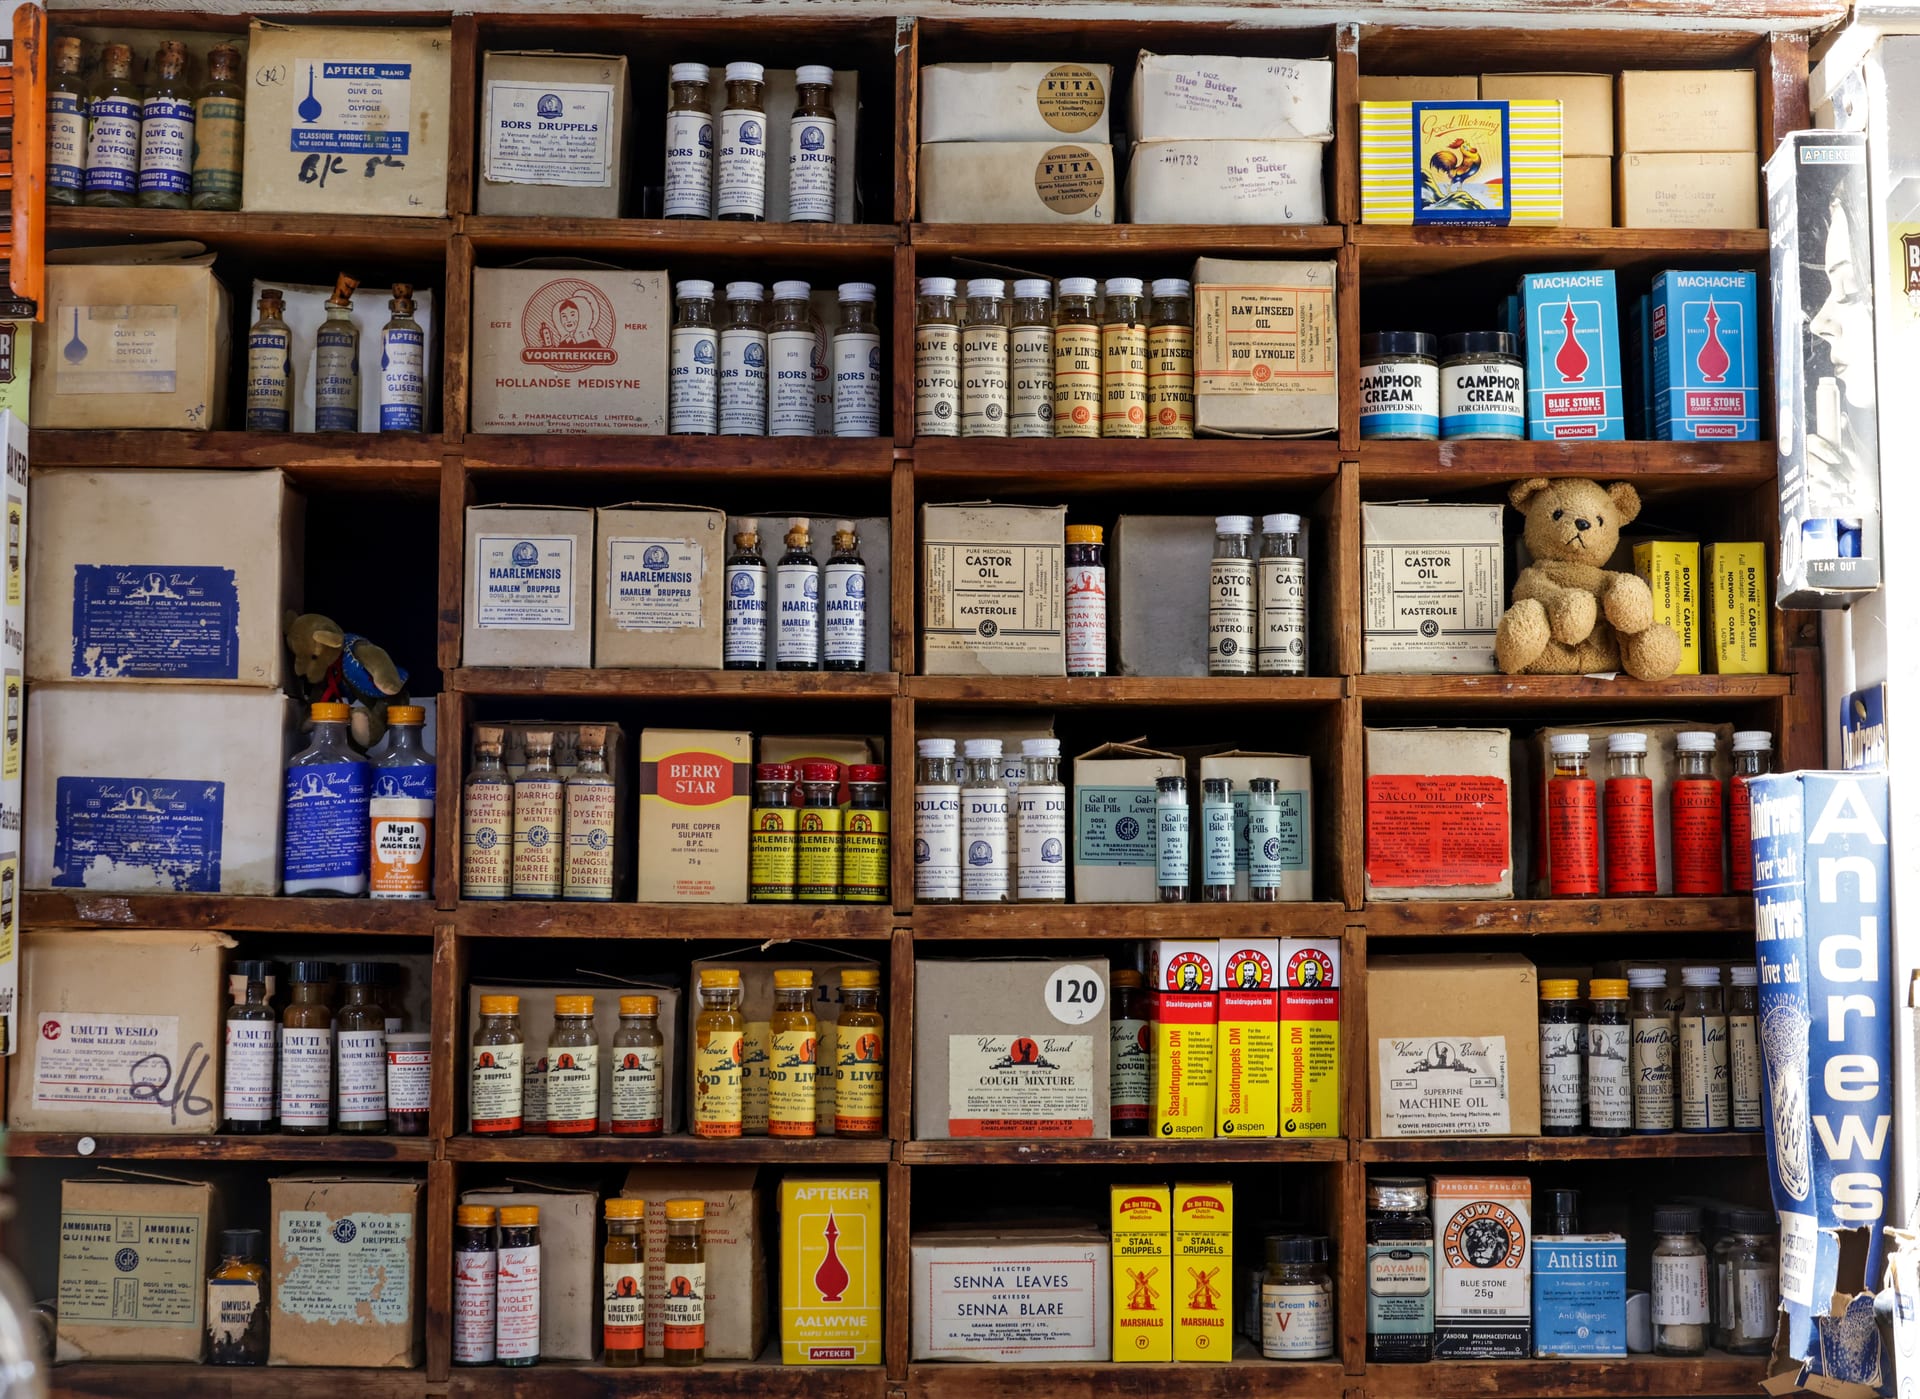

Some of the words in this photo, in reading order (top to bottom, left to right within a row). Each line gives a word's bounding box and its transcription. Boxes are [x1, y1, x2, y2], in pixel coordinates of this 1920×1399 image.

[326, 66, 375, 76] APTEKER
[1048, 80, 1096, 91] FUTA
[1176, 74, 1197, 86] Blue
[1204, 80, 1238, 94] Butter
[500, 120, 531, 129] BORS
[538, 122, 598, 132] DRUPPELS
[1422, 114, 1456, 145] Good
[1458, 113, 1500, 136] Morning
[145, 129, 167, 138] OLIVE
[1045, 162, 1094, 175] FUTA
[1227, 165, 1249, 175] Blue
[1256, 163, 1288, 174] Butter
[1532, 275, 1604, 289] MACHACHE
[1677, 275, 1746, 287] MACHACHE
[1231, 306, 1252, 315] RAW
[1255, 306, 1294, 317] LINSEED
[624, 323, 648, 331] MERK
[1255, 319, 1271, 329] OIL
[964, 341, 998, 352] OLIVE
[1108, 345, 1129, 356] RAW
[525, 351, 612, 361] VOORTREKKER
[1231, 349, 1251, 359] ROU
[1255, 349, 1296, 360] LYNOLIE
[1074, 360, 1090, 371] OIL
[1130, 360, 1144, 371] OIL
[1161, 361, 1176, 371] OIL
[777, 370, 808, 379] BORS
[496, 378, 571, 388] HOLLANDSE
[578, 379, 641, 389] MEDISYNE
[1457, 376, 1520, 390] CAMPHOR
[1108, 391, 1125, 401] ROU
[1365, 389, 1413, 403] CREAM
[1467, 389, 1514, 403] CREAM
[1548, 397, 1571, 408] BLUE
[1572, 396, 1601, 407] STONE
[1690, 397, 1712, 407] BLUE
[1714, 397, 1741, 407] STONE
[965, 556, 1012, 566] CASTOR
[1404, 557, 1451, 567] CASTOR
[1813, 562, 1835, 572] TEAR
[1840, 562, 1856, 571] OUT
[489, 568, 561, 579] HAARLEMENSIS
[620, 571, 692, 583] HAARLEMENSIS
[978, 568, 999, 578] OIL
[1418, 569, 1438, 579] OIL
[1212, 575, 1252, 586] CASTOR
[1683, 567, 1691, 603] BOVINE
[1747, 567, 1756, 603] BOVINE
[489, 584, 520, 593] HAARLEM
[526, 585, 560, 593] DRUPPELS
[620, 588, 651, 596] HAARLEM
[657, 588, 691, 597] DRUPPELS
[1220, 586, 1240, 597] OIL
[1727, 571, 1735, 610] NORWOOD
[960, 606, 1017, 615] KASTEROLIE
[1401, 607, 1457, 616] KASTEROLIE
[1683, 608, 1692, 648] CAPSULE
[1748, 608, 1757, 648] CAPSULE
[1488, 745, 1499, 759] 5
[670, 764, 723, 778] BERRY
[675, 780, 716, 794] STAR
[1089, 795, 1106, 803] Gall
[1378, 792, 1417, 802] SACCO
[1425, 792, 1446, 802] OIL
[1455, 792, 1495, 802] DROPS
[1085, 803, 1102, 812] Bile
[1103, 804, 1121, 813] Pills
[1165, 813, 1181, 822] Gall
[1212, 813, 1228, 822] Gall
[1751, 793, 1801, 841] Andrews
[387, 823, 414, 836] Nyal
[693, 823, 720, 831] COPPER
[1252, 824, 1269, 833] Pills
[678, 831, 712, 839] SULPHATE
[379, 842, 422, 850] MAGNESIA
[572, 857, 608, 866] MENGSEL
[1755, 853, 1773, 881] liver
[1777, 847, 1797, 879] salt
[1755, 895, 1802, 942] Andrews
[1168, 953, 1212, 985] LENNON
[1228, 951, 1271, 983] LENNON
[1288, 950, 1333, 983] LENNON
[1761, 954, 1781, 985] liver
[1784, 953, 1800, 983] salt
[1520, 973, 1530, 983] 2
[1055, 979, 1098, 1003] 120
[1165, 1000, 1202, 1009] Staaldruppels
[1225, 998, 1262, 1006] Staaldruppels
[1807, 779, 1891, 1222] Andrews
[70, 1025, 108, 1036] UMUTI
[114, 1026, 159, 1037] WESILO
[1229, 1028, 1241, 1044] DM
[71, 1037, 95, 1045] WORM
[980, 1076, 1019, 1086] COUGH
[1024, 1076, 1075, 1086] MIXTURE
[1229, 1048, 1243, 1114] Staaldruppels
[1424, 1088, 1463, 1096] SUPERFINE
[1399, 1098, 1461, 1109] MACHINE
[1467, 1097, 1488, 1108] OIL
[1175, 1124, 1203, 1135] aspen
[1236, 1122, 1264, 1132] aspen
[1299, 1121, 1327, 1131] aspen
[795, 1187, 869, 1200] APTEKER
[62, 1222, 111, 1231] AMMONIATED
[1447, 1204, 1491, 1241] LEEUW
[63, 1234, 112, 1242] QUININE
[148, 1237, 190, 1245] KINIEN
[288, 1235, 322, 1243] DROPS
[362, 1236, 406, 1244] DRUPPELS
[1129, 1237, 1154, 1246] STAAL
[1191, 1237, 1216, 1245] STAAL
[1495, 1209, 1521, 1267] BRAND
[1121, 1246, 1162, 1255] DRUPPELS
[1448, 1247, 1465, 1267] DE
[1547, 1252, 1618, 1269] Antistin
[1376, 1264, 1426, 1273] DAYAMIN
[953, 1276, 1005, 1289] SENNA
[1016, 1275, 1069, 1288] LEAVES
[1474, 1288, 1494, 1298] 25g
[502, 1295, 532, 1304] VIOLET
[221, 1301, 251, 1311] UMVUSA
[957, 1303, 1009, 1316] SENNA
[1020, 1303, 1064, 1315] BLARE
[795, 1315, 868, 1327] AALWYNE
[1120, 1318, 1164, 1327] MARSHALLS
[1275, 1312, 1292, 1332] V
